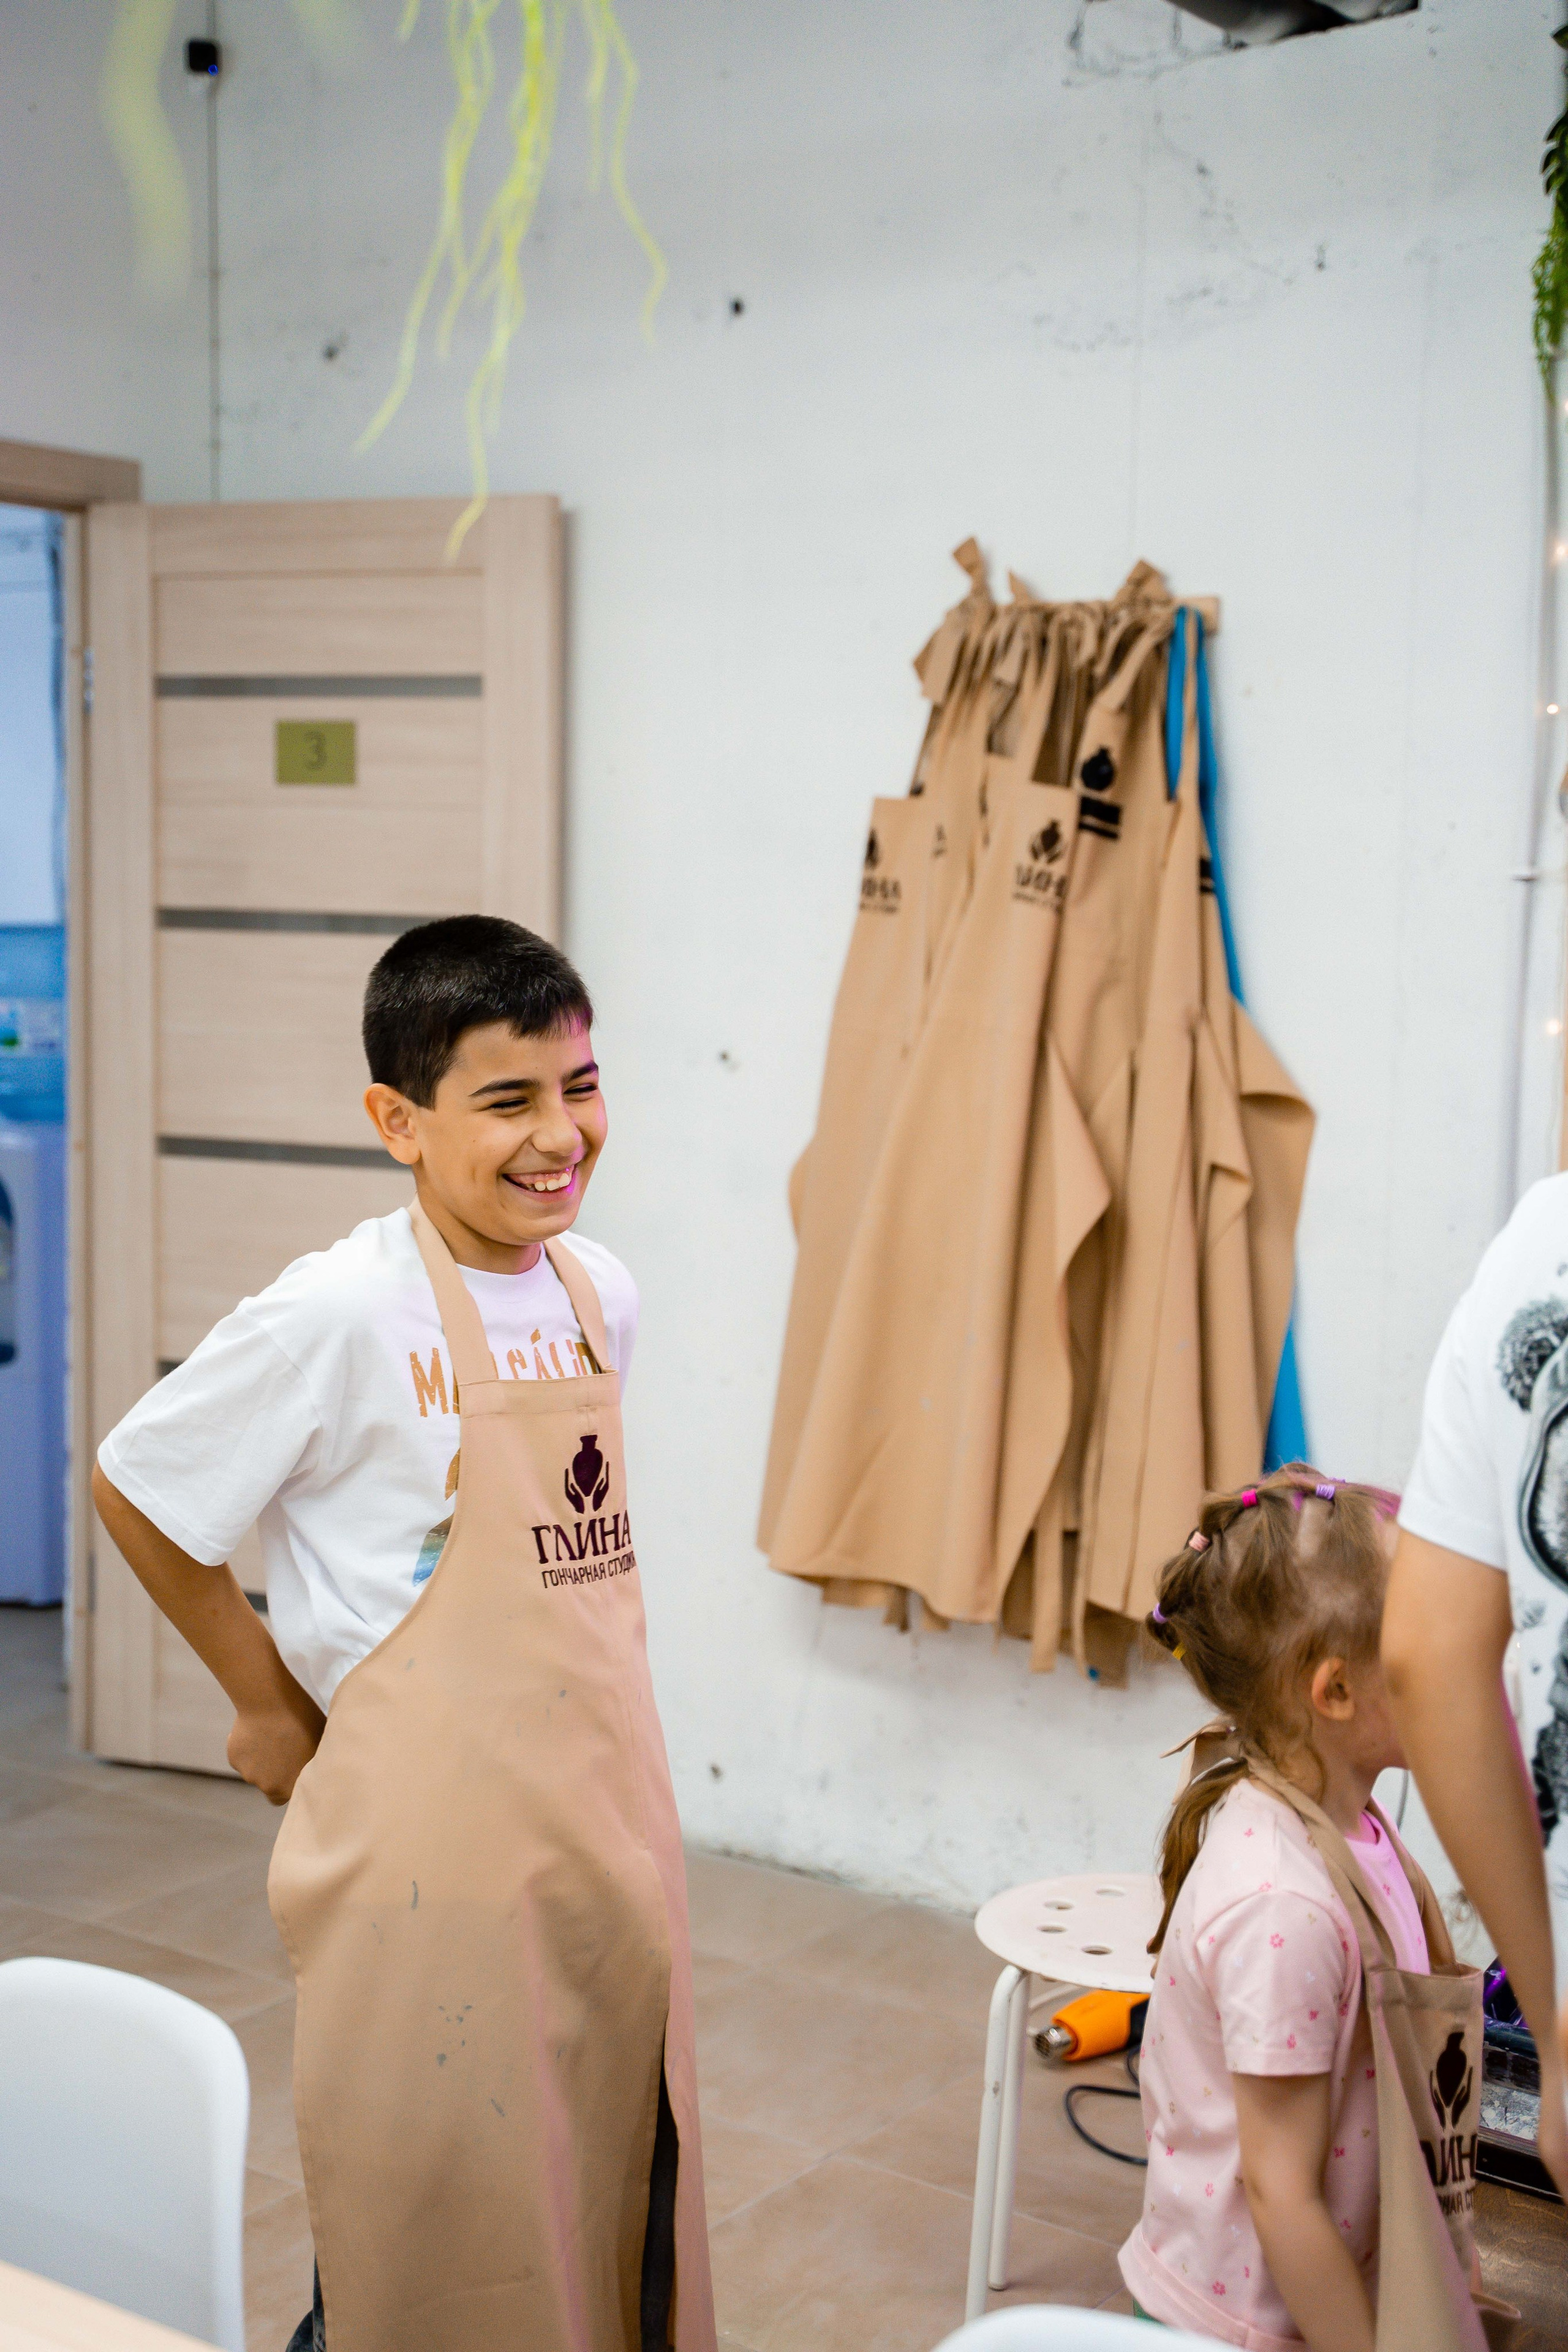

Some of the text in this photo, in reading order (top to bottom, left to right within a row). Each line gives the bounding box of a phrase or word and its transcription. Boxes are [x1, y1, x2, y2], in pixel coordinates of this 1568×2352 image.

[305, 729, 328, 770] 3
[531, 1510, 631, 1564] ГЛИНА
[541, 1562, 607, 1588] ГОНЧАРНАЯ
